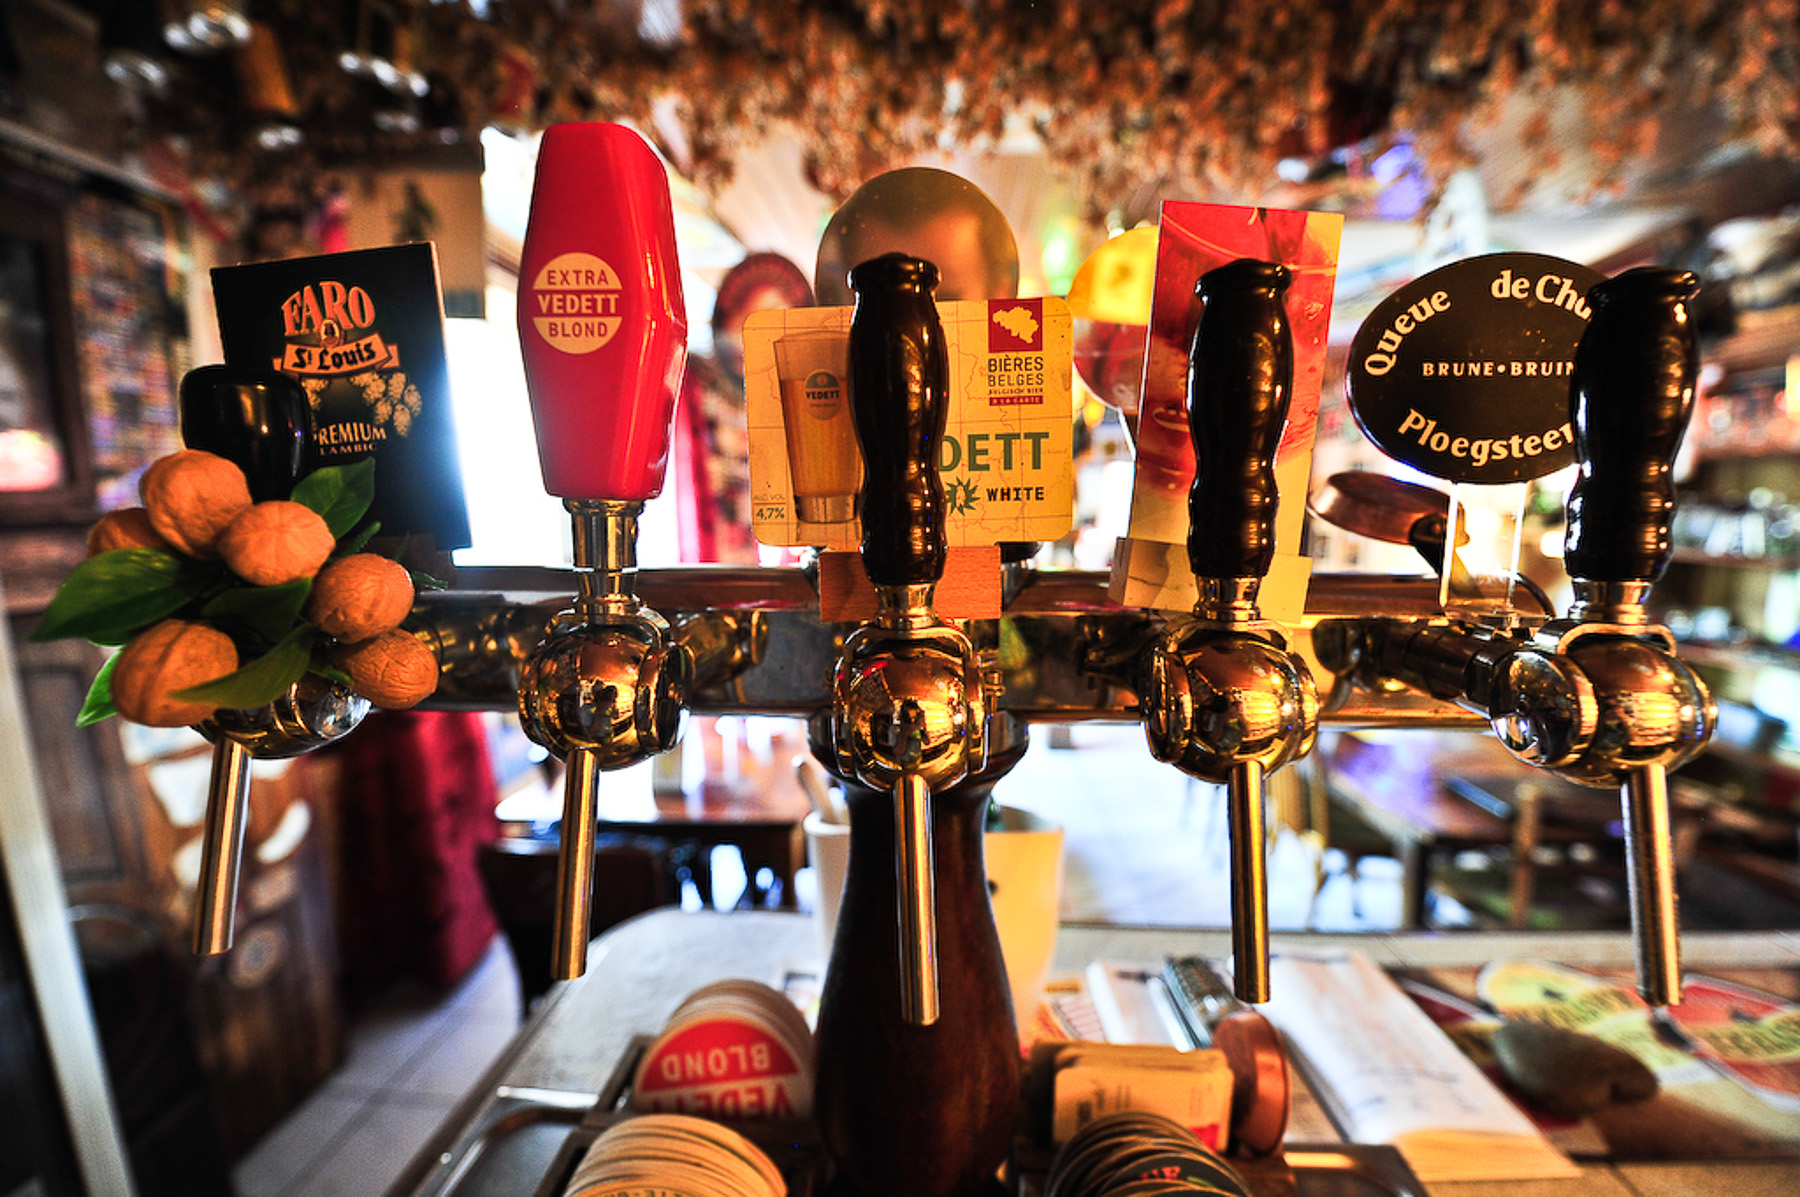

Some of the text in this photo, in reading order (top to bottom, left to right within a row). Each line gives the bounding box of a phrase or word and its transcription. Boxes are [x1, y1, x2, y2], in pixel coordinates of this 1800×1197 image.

[547, 269, 609, 286] EXTRA
[281, 280, 375, 336] FARO
[537, 294, 620, 314] VEDETT
[548, 321, 608, 338] BLOND
[1364, 290, 1451, 377] Queue
[1491, 269, 1531, 299] de
[318, 342, 377, 371] Louis
[988, 354, 1044, 373] BIÈRES
[988, 373, 1044, 387] BELGES
[805, 390, 841, 400] VEDETT
[313, 422, 387, 446] REMIUM
[986, 486, 1045, 502] WHITE
[756, 507, 785, 520] 4,7%
[661, 1042, 770, 1082] BLOND
